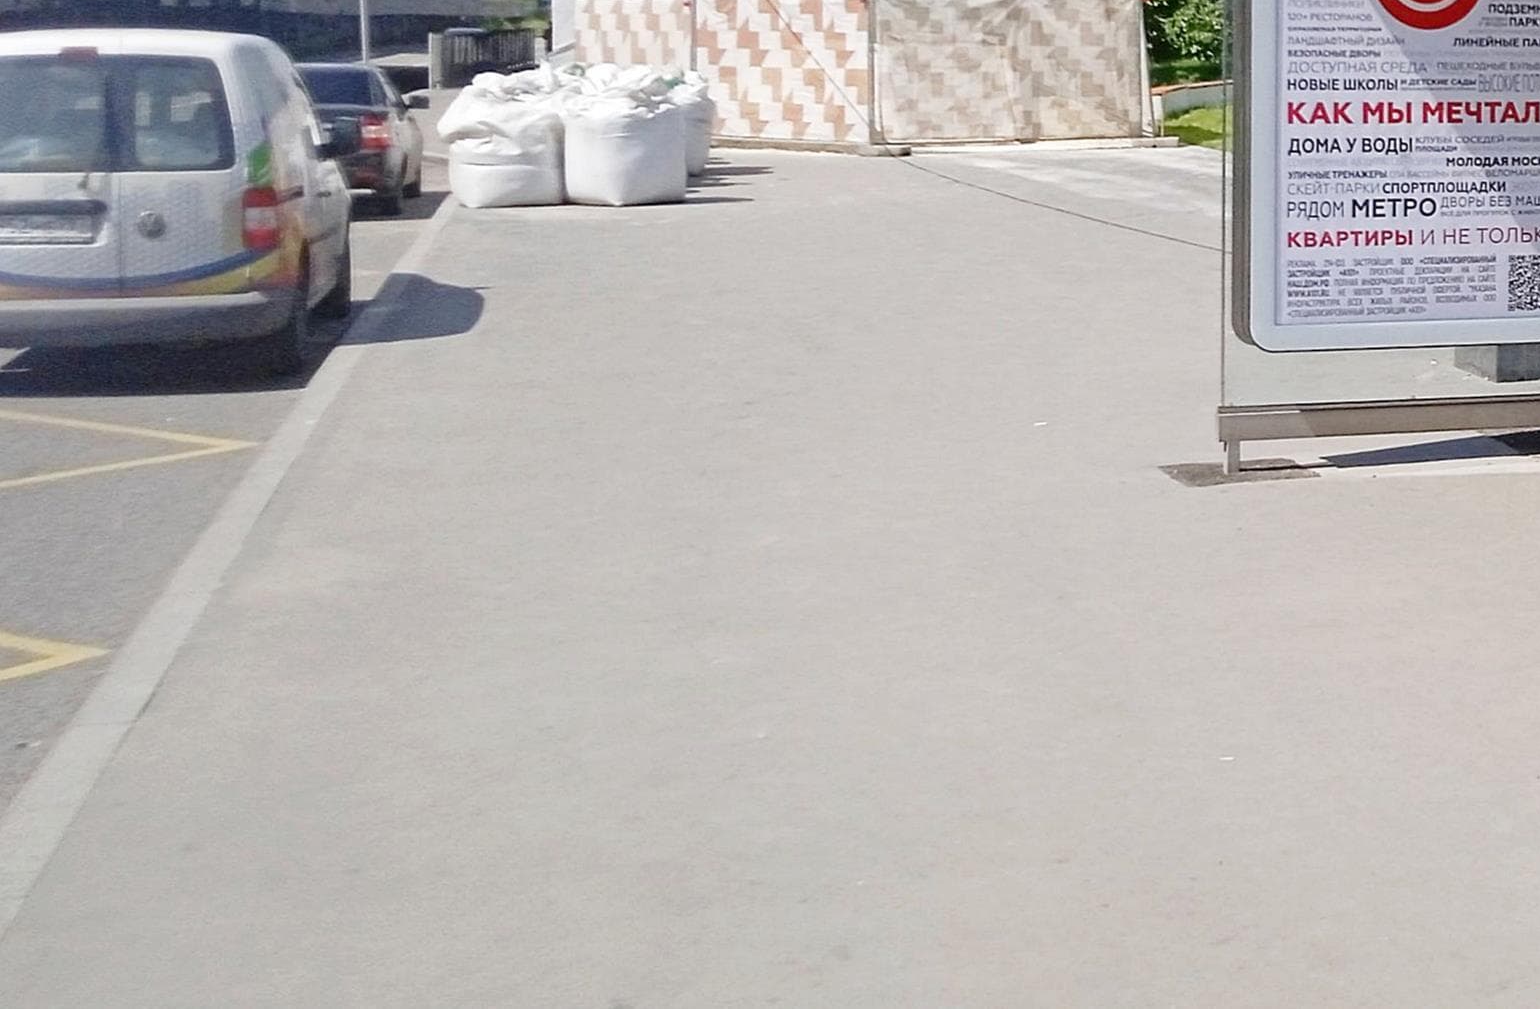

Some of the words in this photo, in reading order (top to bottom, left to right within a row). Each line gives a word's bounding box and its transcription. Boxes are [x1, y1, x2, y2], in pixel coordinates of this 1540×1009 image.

[1453, 36, 1519, 47] ЛИНЕЙНЫЕ
[1349, 50, 1381, 58] ДВОРЫ
[1288, 61, 1376, 74] ДОСТУПНАЯ
[1381, 61, 1427, 74] СРЕДА
[1287, 79, 1340, 91] НОВЫЕ
[1343, 79, 1398, 91] ШКОЛЫ
[1288, 102, 1353, 124] КАК
[1362, 102, 1412, 124] МЫ
[1455, 135, 1504, 144] СОСЕДЕЙ
[1288, 139, 1341, 155] ДОМА
[1346, 139, 1357, 153] У
[1362, 138, 1413, 155] ВОДЫ
[1446, 156, 1508, 167] МОЛОДАЯ
[1288, 171, 1330, 179] УЛИЧНЫЕ
[1382, 181, 1506, 194] СПОРТПЛОЩАДКИ
[1287, 201, 1344, 220] РЯДОМ
[1352, 197, 1437, 218] МЕТРО
[1441, 196, 1485, 208] ДВОРЫ
[1489, 196, 1511, 207] БЕЗ
[1288, 230, 1413, 248] КВАРТИРЫ
[1421, 230, 1435, 245] И
[1443, 229, 1470, 245] НЕ
